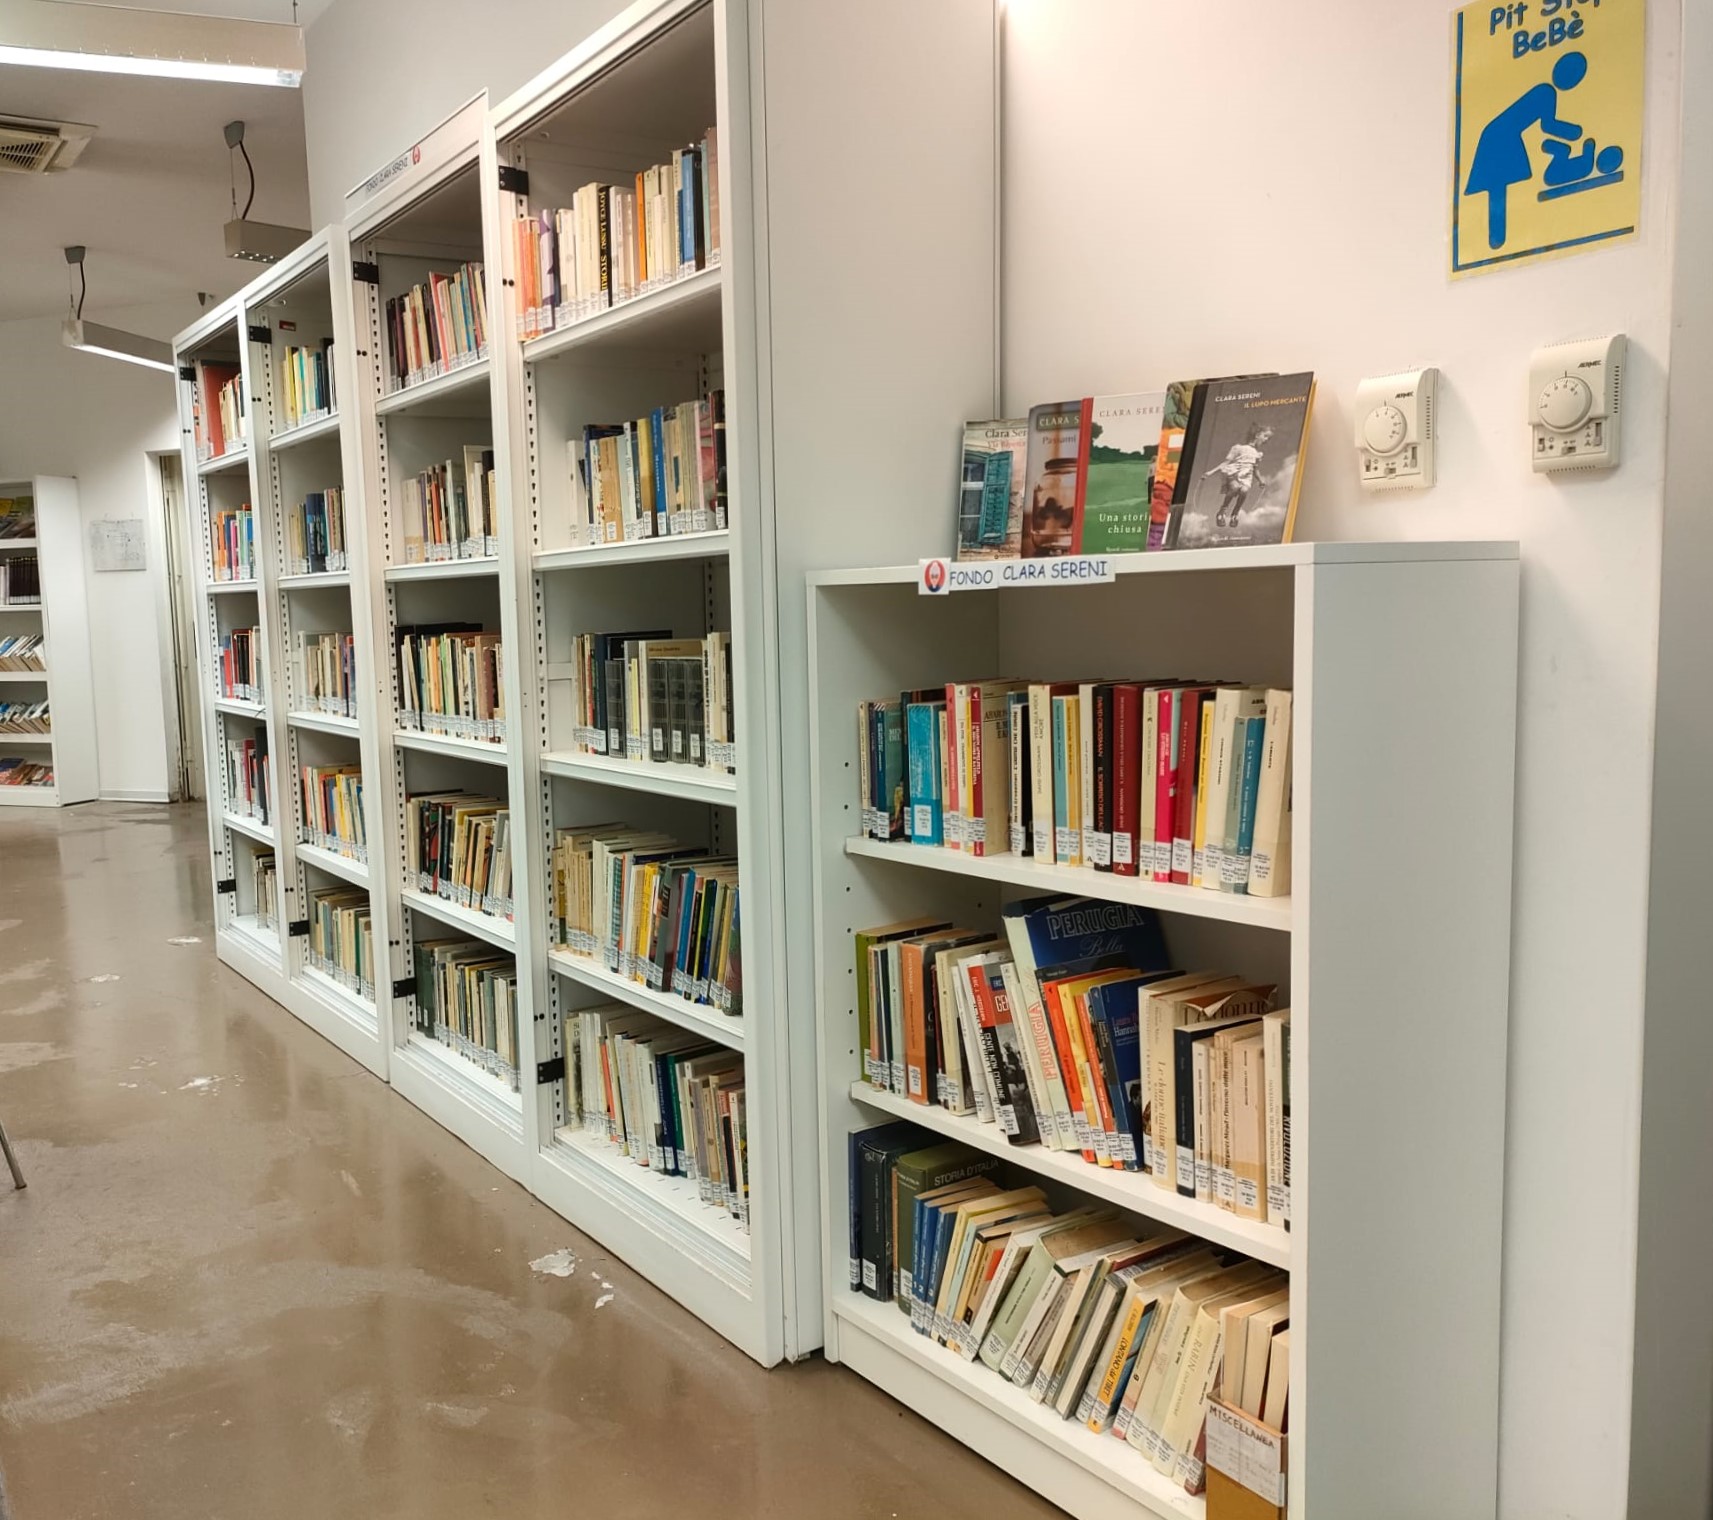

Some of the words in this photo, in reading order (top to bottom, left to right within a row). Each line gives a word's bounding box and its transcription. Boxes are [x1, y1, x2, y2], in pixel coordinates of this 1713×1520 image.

[1490, 2, 1528, 36] Pit
[1513, 10, 1584, 59] BeBè
[1237, 392, 1261, 400] SERENI
[1251, 399, 1269, 408] LUPO
[1270, 396, 1307, 407] MERCANTE
[1040, 415, 1070, 427] CLARA
[1099, 406, 1132, 418] CLARA
[985, 428, 1010, 439] Clara
[1099, 512, 1119, 523] Una
[1107, 524, 1142, 535] chiusa
[950, 569, 994, 586] FONDO
[1003, 564, 1046, 581] CLARA
[1051, 560, 1108, 579] SERENI
[1046, 903, 1144, 940] PERUGIA
[985, 1032, 993, 1047] GENTE
[989, 1047, 997, 1063] NON
[1028, 1001, 1058, 1081] PERUGIA
[934, 1170, 965, 1187] STORIA
[967, 1158, 999, 1176] D'ITALIA
[1209, 1404, 1275, 1449] MISCELLANEA
